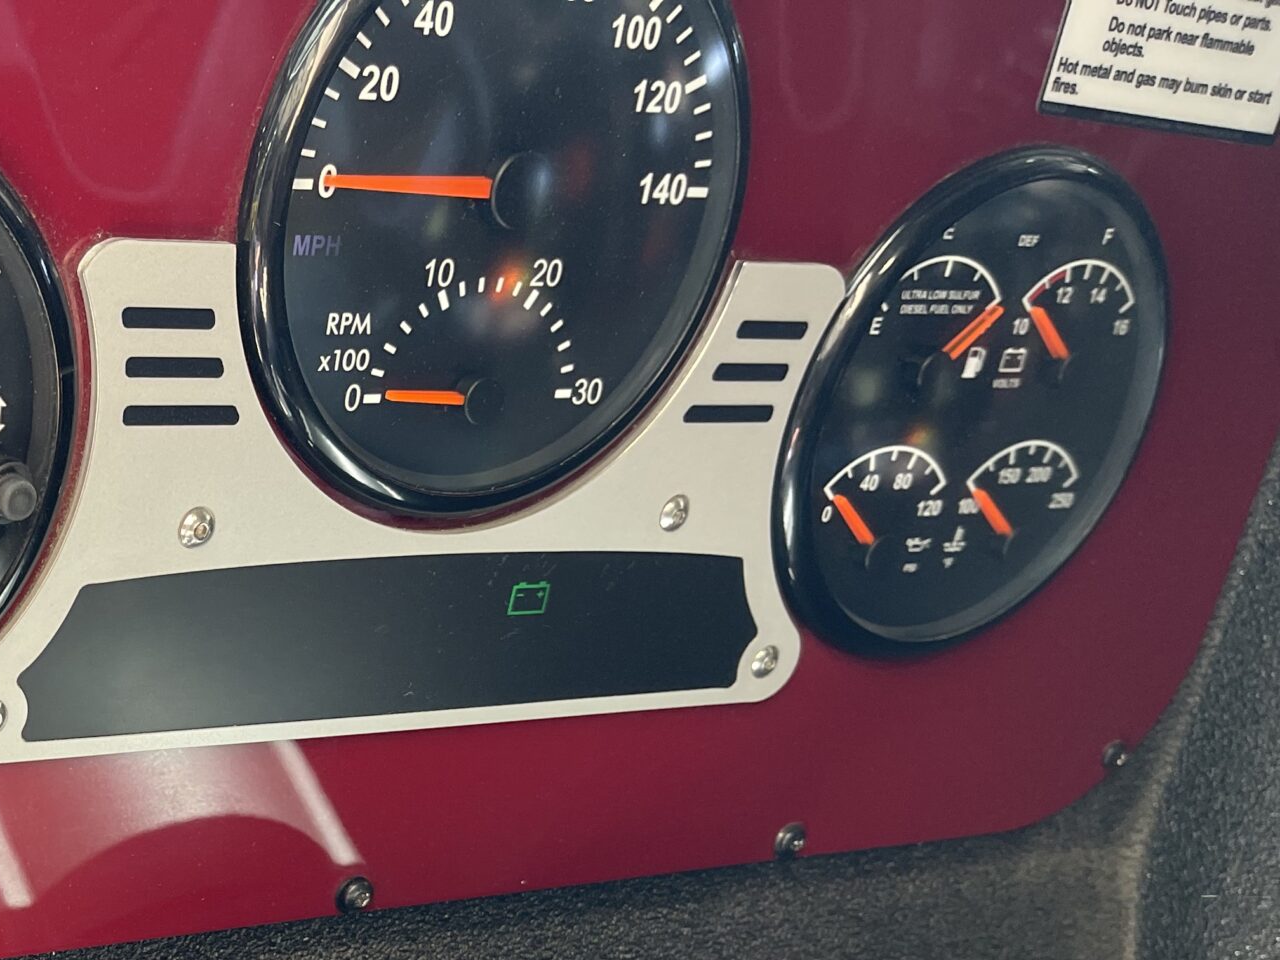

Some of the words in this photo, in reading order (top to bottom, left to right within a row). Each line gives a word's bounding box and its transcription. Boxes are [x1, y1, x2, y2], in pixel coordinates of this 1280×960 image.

[414, 0, 454, 37] 40
[1164, 0, 1197, 17] Touch
[1196, 5, 1228, 24] pipes
[1230, 14, 1243, 25] or
[1241, 16, 1271, 32] parts.
[612, 13, 662, 50] 100
[1108, 16, 1125, 33] Do
[1127, 23, 1147, 37] not
[1146, 26, 1173, 41] park
[1174, 32, 1199, 46] near
[1200, 32, 1255, 56] flammable
[1102, 37, 1144, 58] objects.
[359, 65, 400, 101] 20
[1051, 76, 1079, 95] fires.
[1057, 56, 1079, 74] Hot
[1080, 64, 1113, 79] metal
[1113, 69, 1136, 83] and
[1135, 73, 1157, 88] gas
[1158, 77, 1183, 94] may
[1183, 77, 1209, 95] burn
[1210, 83, 1232, 99] skin
[1234, 89, 1247, 100] or
[1247, 89, 1272, 105] start
[633, 80, 682, 114] 120
[318, 164, 337, 199] 0
[638, 173, 688, 205] 140
[293, 235, 341, 256] MPH
[1018, 234, 1040, 247] DEF
[1101, 228, 1115, 245] F
[424, 259, 455, 288] 10
[529, 259, 563, 288] 20
[901, 290, 927, 300] ULTRA
[928, 290, 947, 300] LOW
[1056, 287, 1074, 304] 12
[1090, 288, 1107, 304] 14
[900, 304, 927, 314] DIESEL
[929, 304, 949, 314] FUEL
[951, 304, 974, 314] ONLY
[325, 313, 371, 335] RPM
[869, 317, 883, 335] E
[1013, 318, 1029, 335] 10
[318, 350, 369, 372] x100
[344, 384, 360, 411] 0
[571, 379, 602, 404] 30
[860, 474, 879, 491] 40
[893, 473, 913, 490] 80
[821, 505, 832, 523] 0
[917, 500, 943, 516] 120
